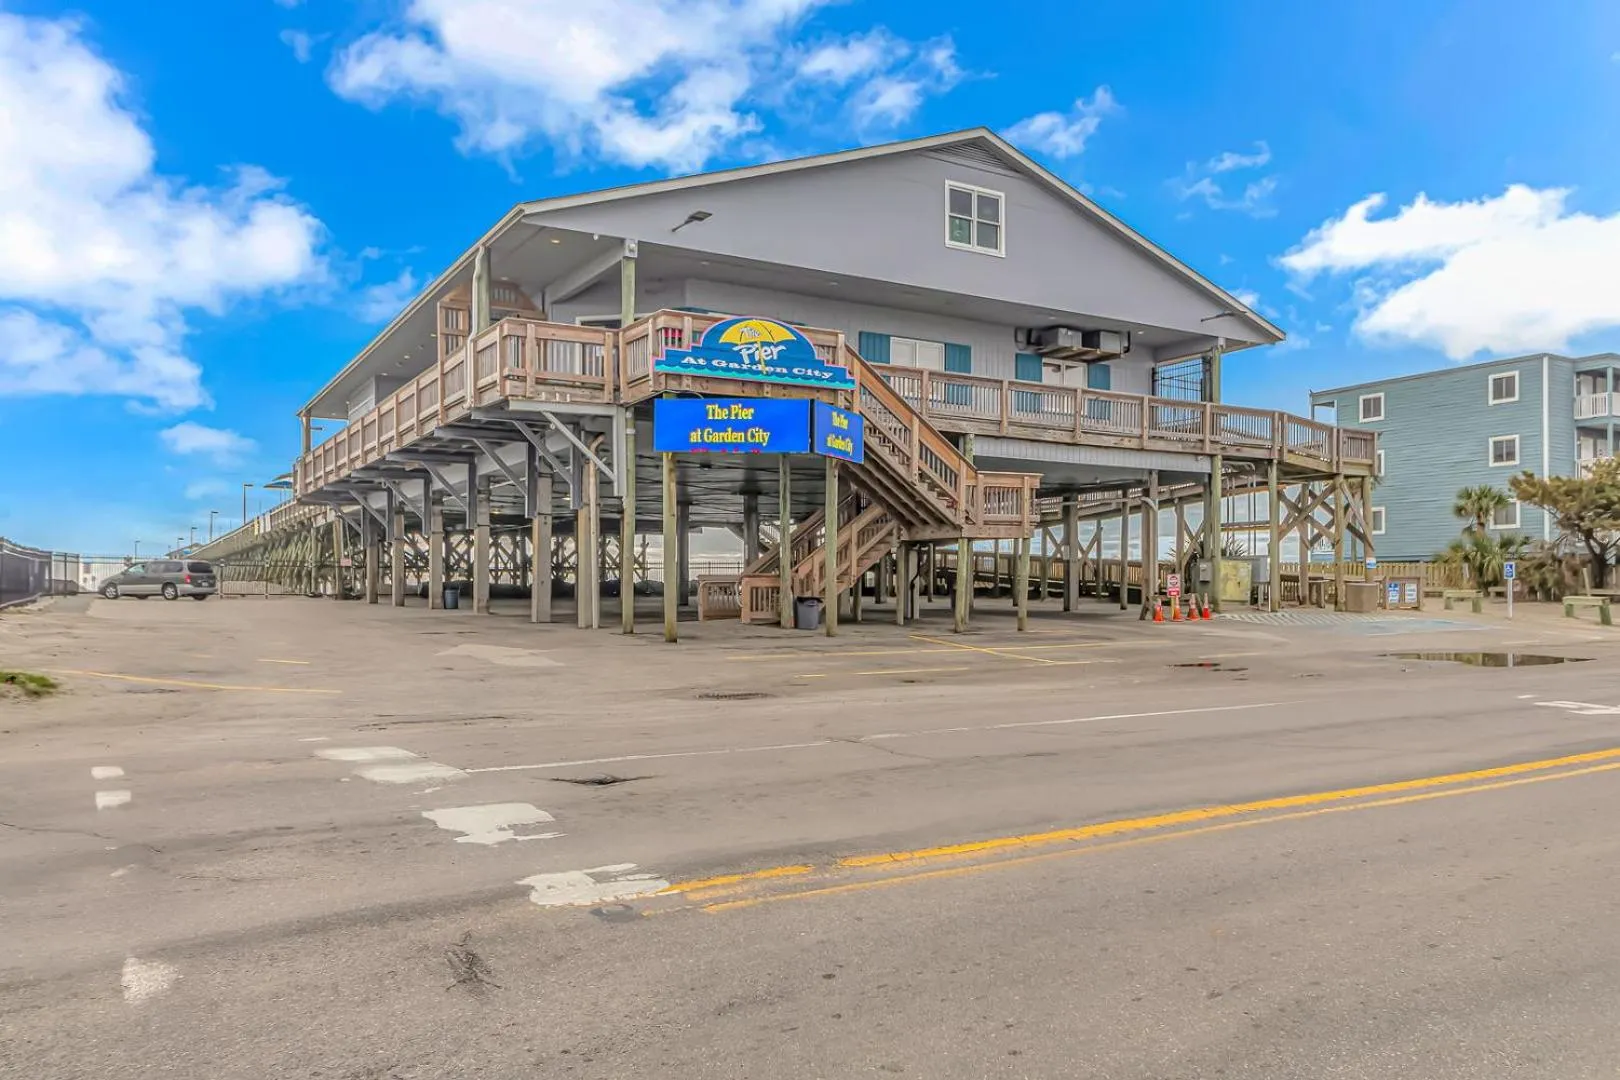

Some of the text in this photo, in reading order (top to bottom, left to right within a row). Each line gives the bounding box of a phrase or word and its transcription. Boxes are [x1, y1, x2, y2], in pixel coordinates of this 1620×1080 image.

[740, 327, 762, 339] The
[732, 342, 787, 364] Pier
[681, 356, 833, 379] At Garden City
[706, 404, 754, 420] The Pier
[832, 411, 848, 430] The Pier
[690, 426, 770, 446] at Garden City
[827, 433, 831, 447] at
